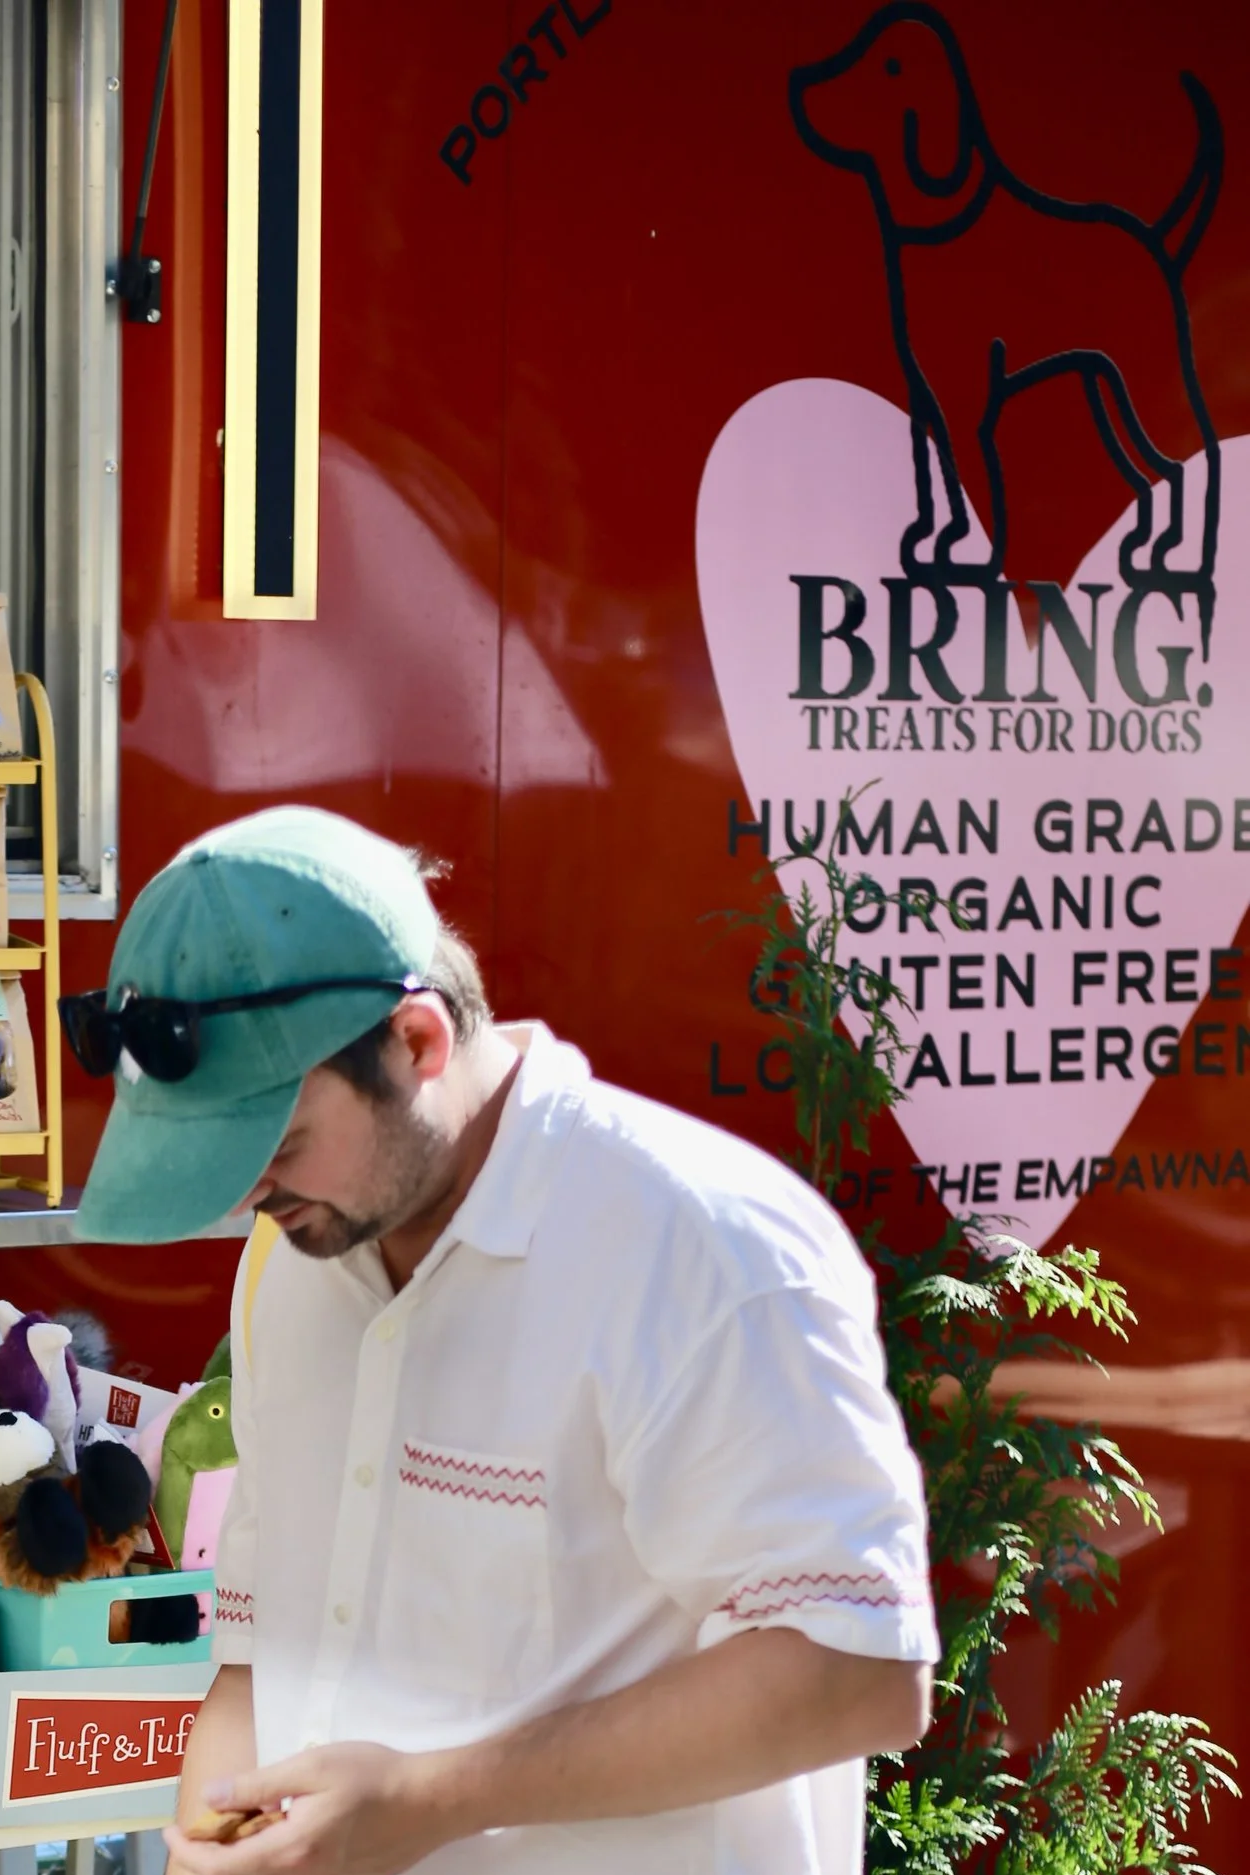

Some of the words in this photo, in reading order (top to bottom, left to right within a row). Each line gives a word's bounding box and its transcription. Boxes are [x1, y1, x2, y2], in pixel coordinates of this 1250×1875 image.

[788, 574, 1215, 708] BRING!
[801, 705, 977, 753] TREATS
[989, 708, 1075, 754] FOR
[1088, 709, 1203, 754] DOGS
[726, 799, 1000, 856] HUMAN
[843, 874, 1163, 934] ORGANIC
[749, 952, 1037, 1014] GUTEN
[1072, 946, 1245, 1006] FREE
[910, 1162, 1002, 1204] THE
[23, 1715, 108, 1777] Fluff
[112, 1736, 142, 1762] &
[139, 1712, 196, 1767] Tuf
